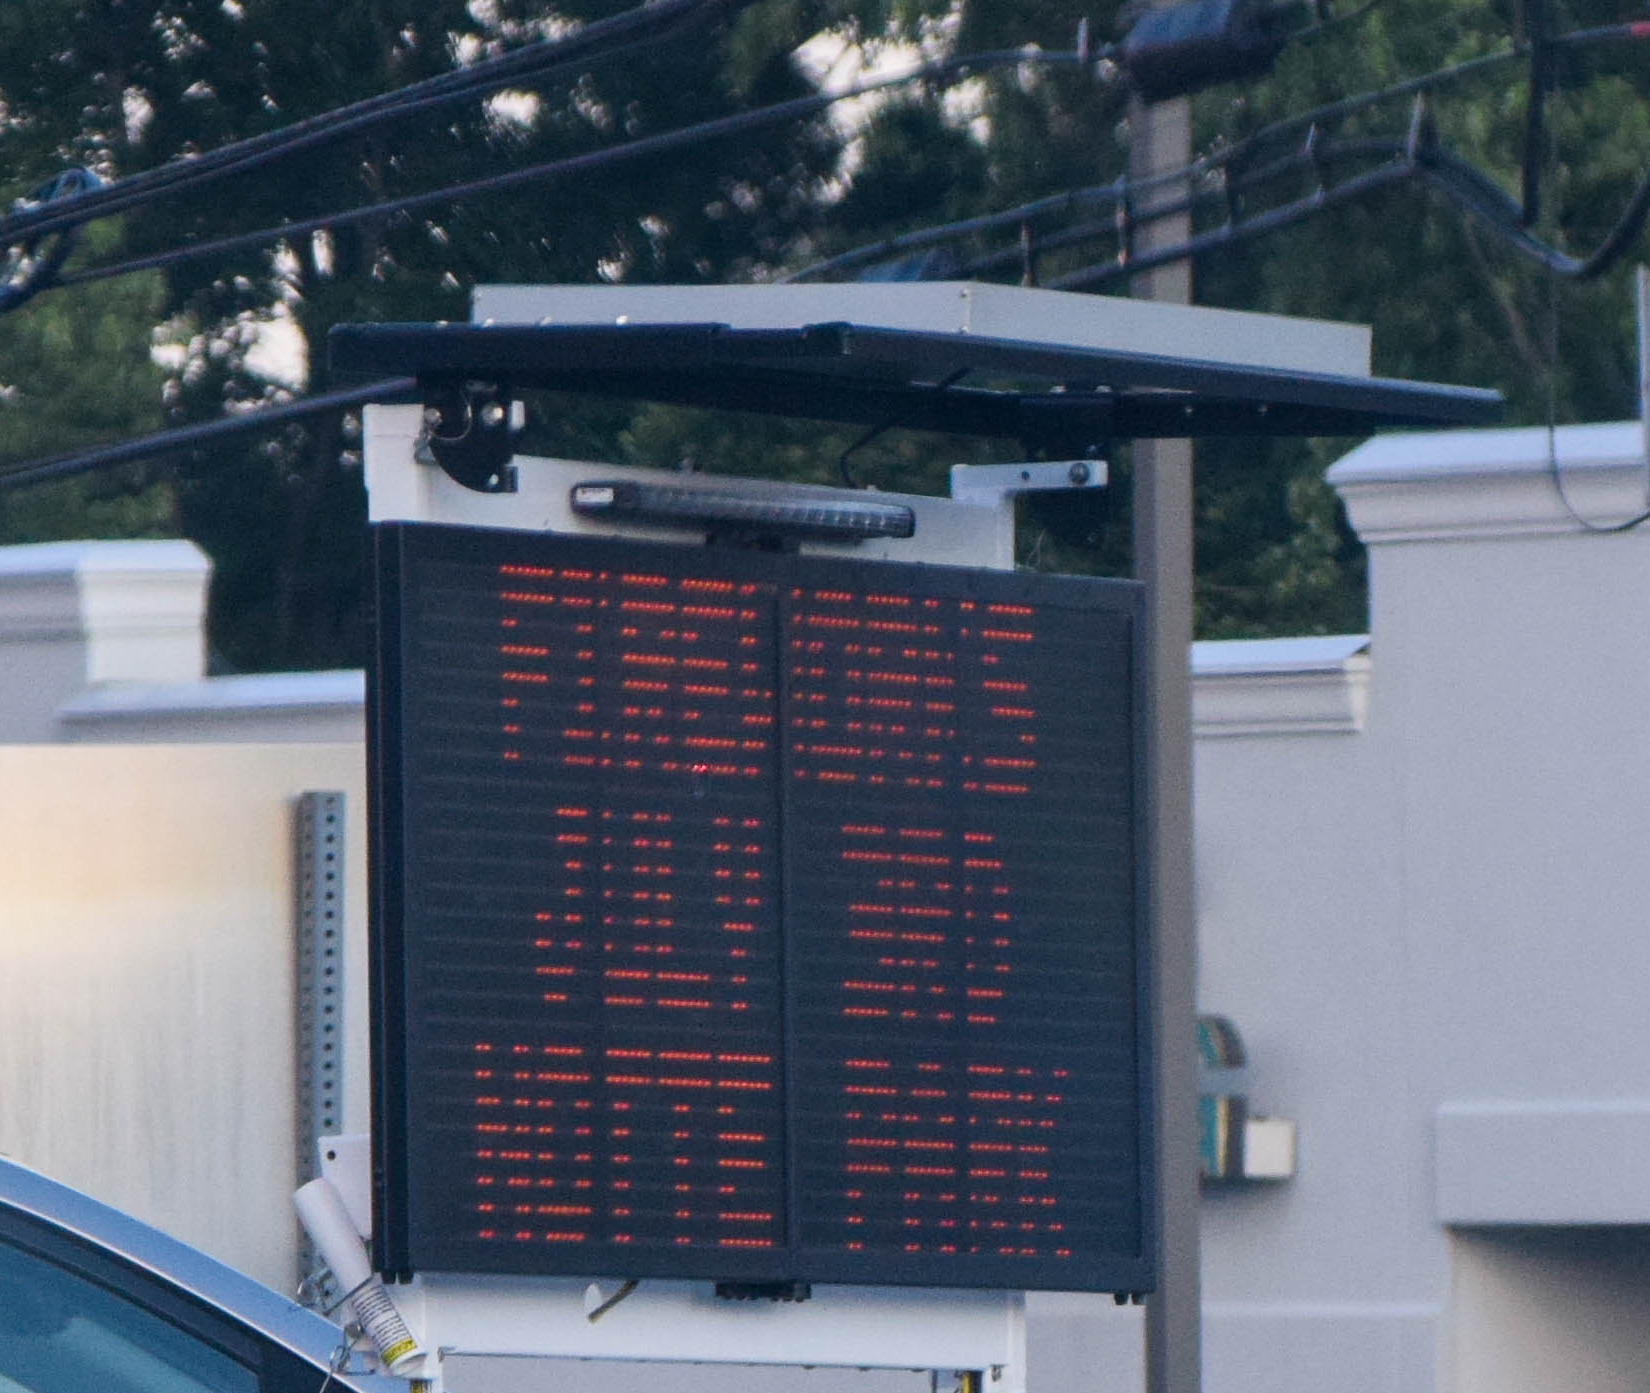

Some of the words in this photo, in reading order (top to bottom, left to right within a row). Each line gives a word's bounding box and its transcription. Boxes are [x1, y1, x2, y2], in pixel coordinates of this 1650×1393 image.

[501, 565, 1034, 792] FIREWORKS
[535, 808, 759, 1010] JULY
[843, 826, 1008, 1022] 3RD
[475, 1044, 771, 1246] NOTTE
[845, 1060, 1069, 1256] PARK
